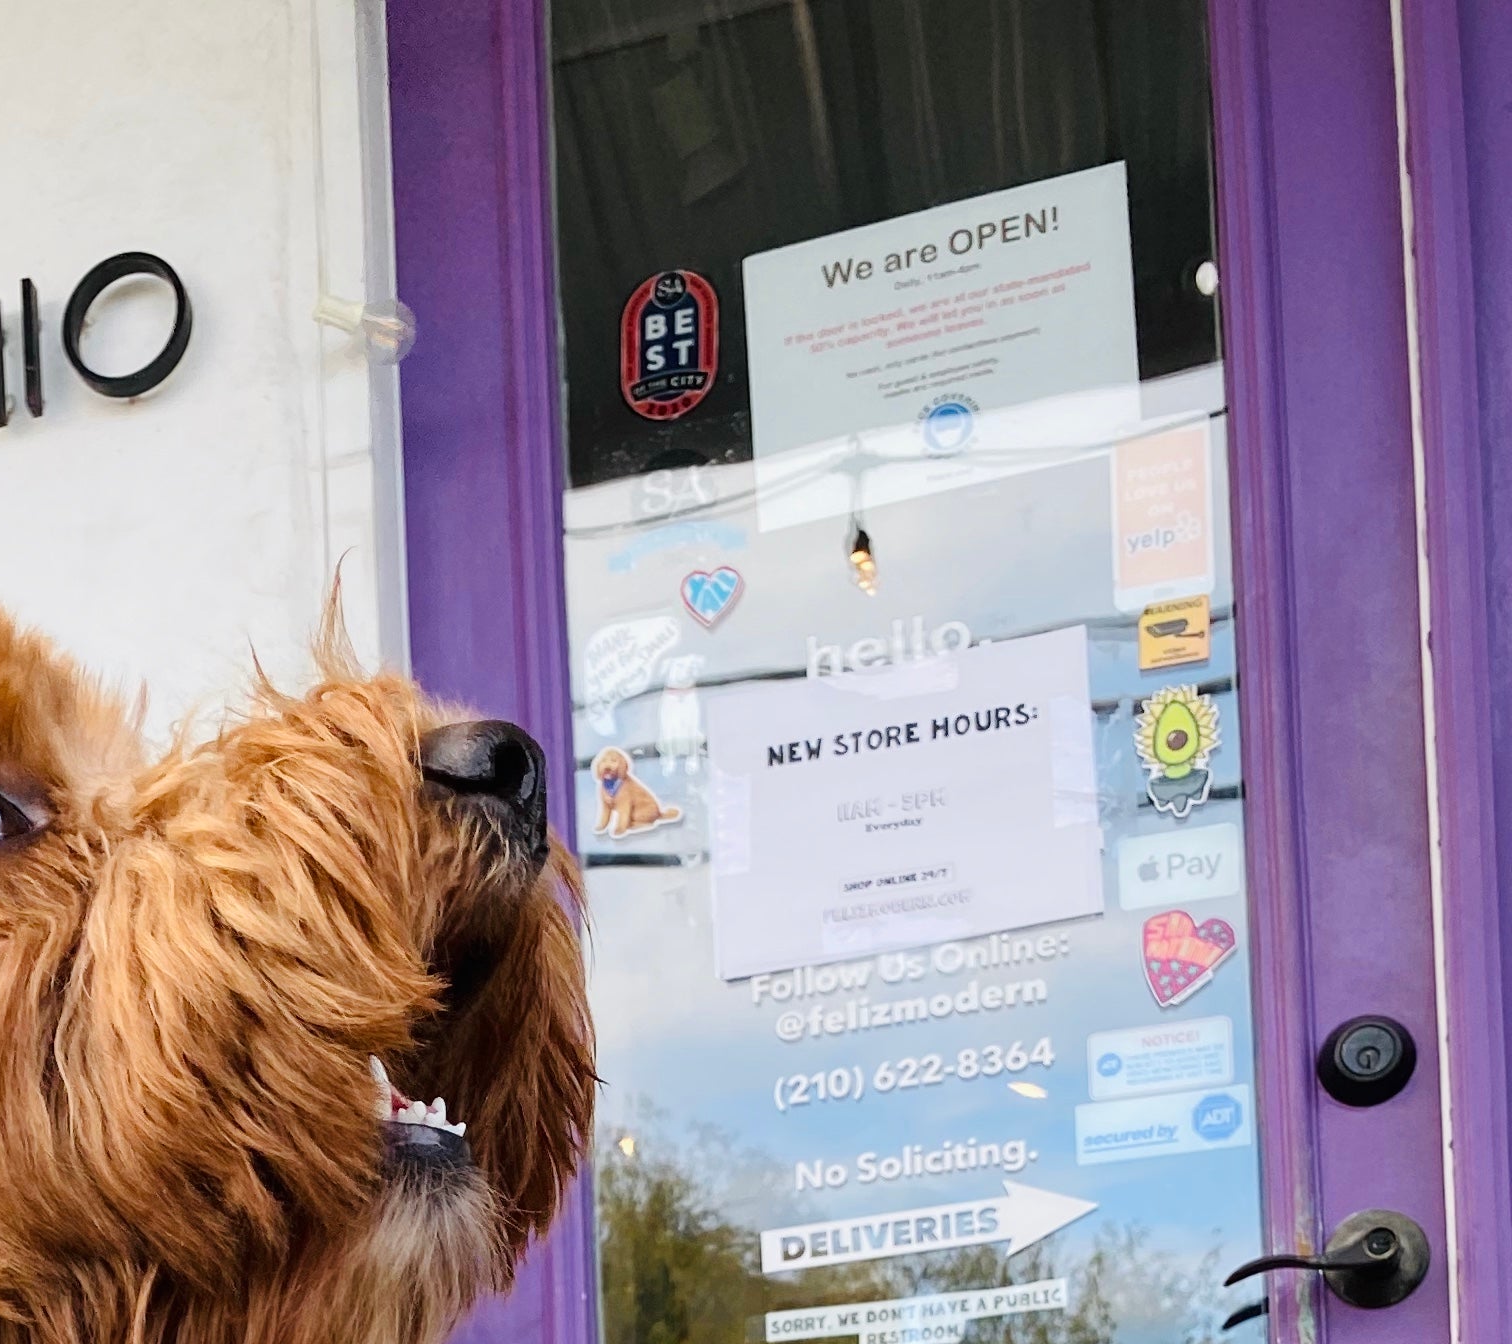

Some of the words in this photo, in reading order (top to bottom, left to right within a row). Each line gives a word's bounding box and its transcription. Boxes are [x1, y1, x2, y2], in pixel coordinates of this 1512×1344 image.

[821, 257, 873, 288] We
[884, 243, 937, 273] are
[949, 206, 1059, 255] OPEN!
[670, 375, 705, 387] CITY
[1127, 528, 1177, 553] yelp
[767, 738, 823, 768] NEW
[833, 721, 921, 756] STORE
[930, 702, 1039, 742] HOURS:
[864, 815, 923, 833] Everyday
[1166, 851, 1224, 880] Pay
[750, 962, 873, 1005] Follow
[878, 952, 926, 984] Us
[933, 933, 1071, 974] Online:
[774, 977, 1049, 1043] @felizmodern
[1141, 1030, 1200, 1048] NOTICE!
[773, 1065, 866, 1113] (210)
[873, 1036, 1057, 1093] 622-8364
[1083, 1125, 1154, 1147] secured
[1156, 1122, 1180, 1142] by
[1200, 1106, 1235, 1128] ADT
[794, 1158, 848, 1192] No
[856, 1136, 1039, 1184] Soliciting.
[781, 1207, 1000, 1261] DELIVERIES
[837, 1312, 861, 1327] WE
[865, 1304, 916, 1323] DON'T
[921, 1298, 970, 1319] HAVE
[976, 1295, 988, 1311] A
[993, 1287, 1062, 1309] PUBLIC
